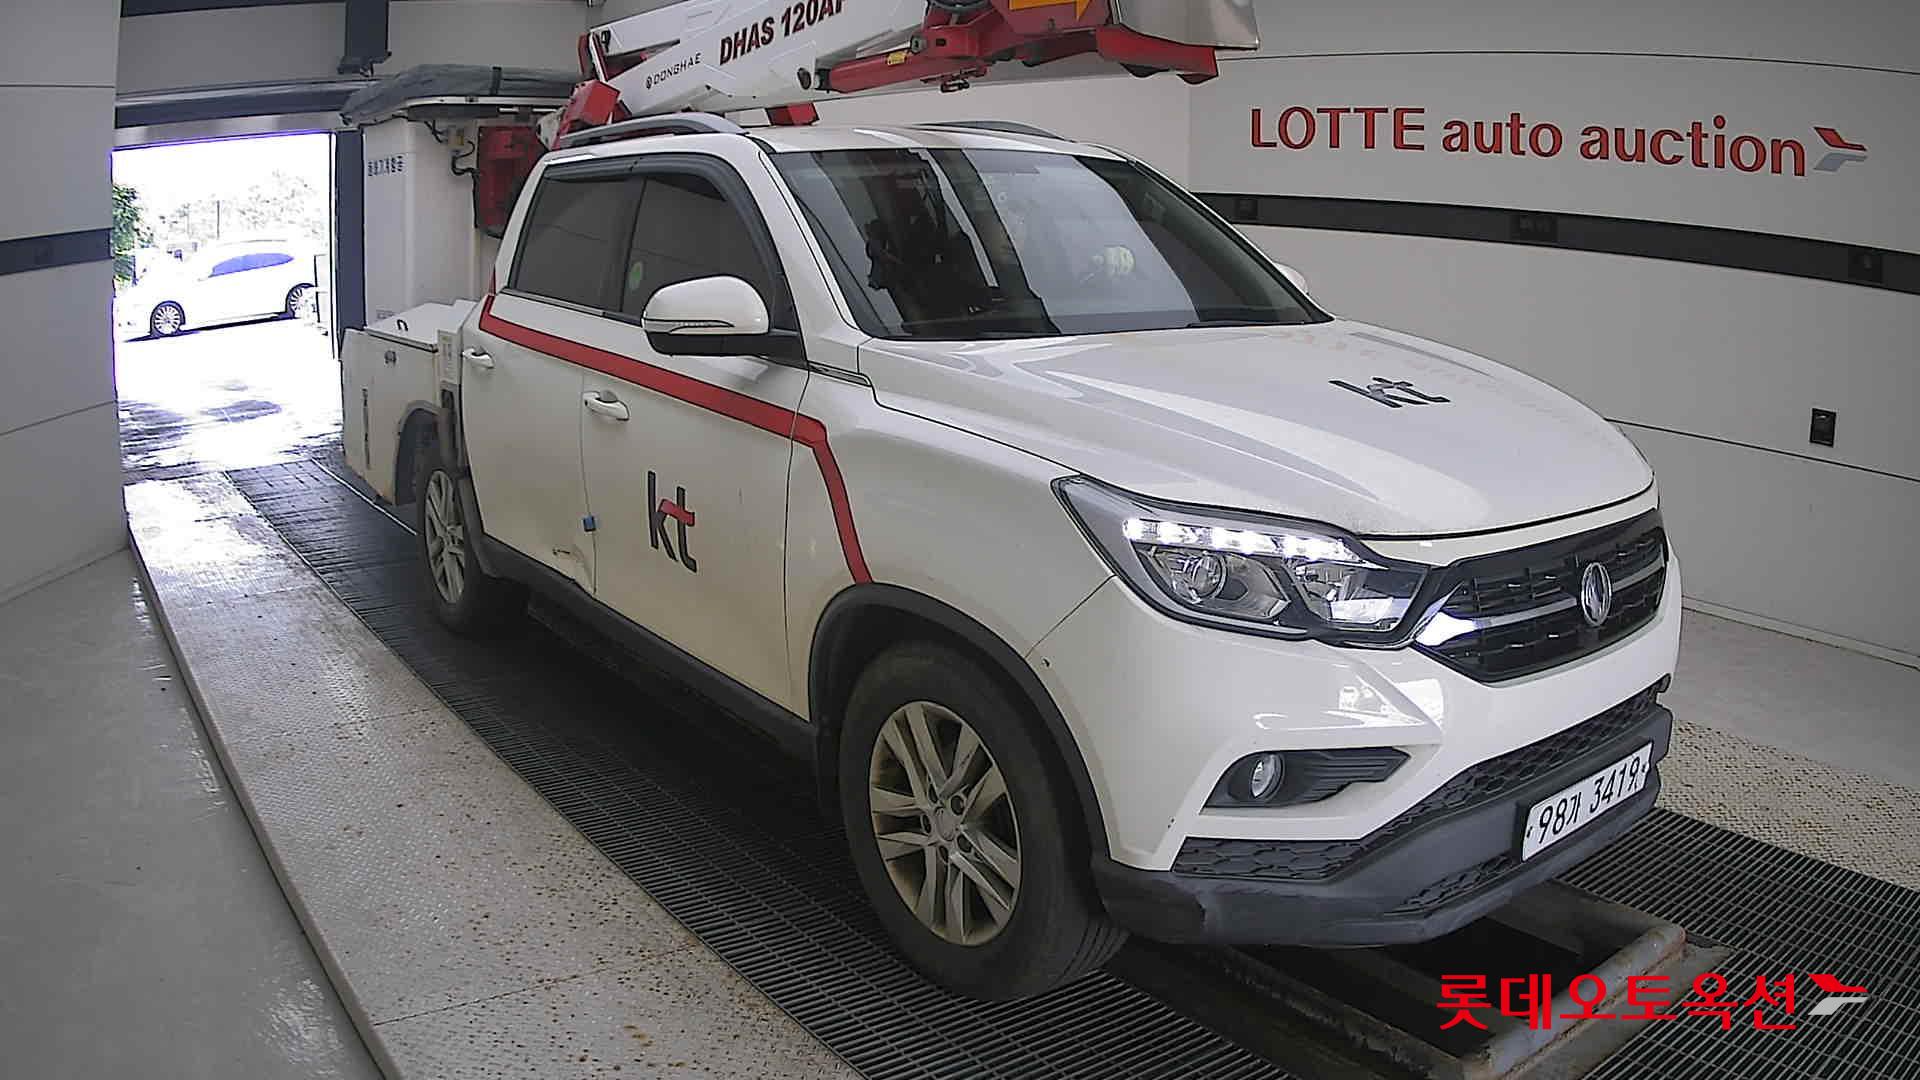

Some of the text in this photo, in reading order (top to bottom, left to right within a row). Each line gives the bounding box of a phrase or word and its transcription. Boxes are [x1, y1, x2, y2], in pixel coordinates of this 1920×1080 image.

[653, 52, 701, 85] DONGHAE
[719, 16, 774, 66] DHAS
[1251, 106, 1805, 177] LOTTE auto auction
[1328, 377, 1450, 408] kt
[648, 470, 697, 573] kt
[1538, 756, 1640, 844] 98가 3419
